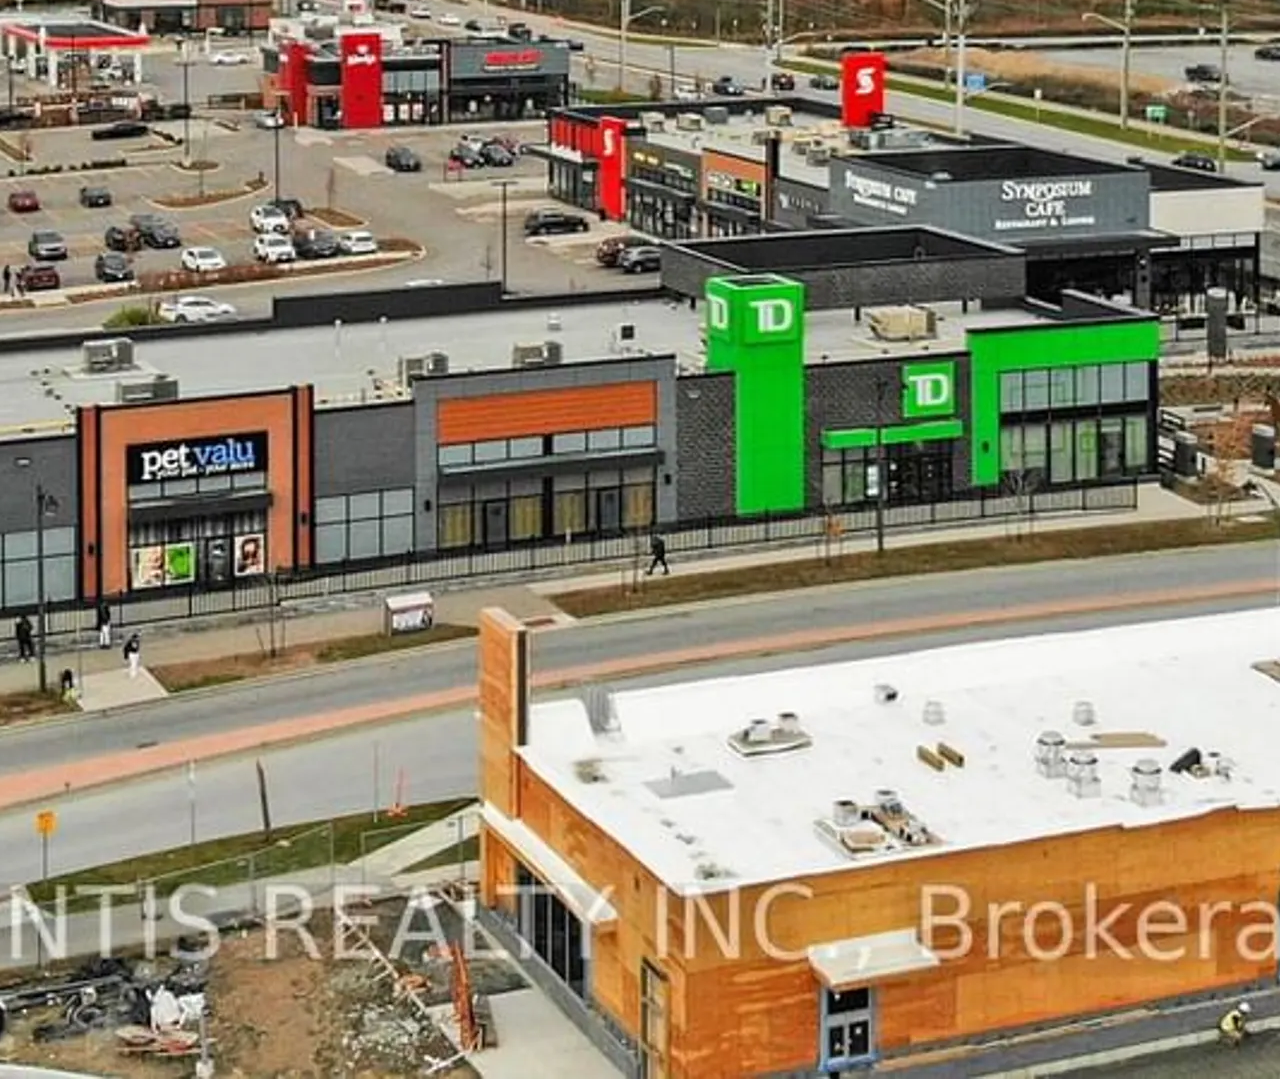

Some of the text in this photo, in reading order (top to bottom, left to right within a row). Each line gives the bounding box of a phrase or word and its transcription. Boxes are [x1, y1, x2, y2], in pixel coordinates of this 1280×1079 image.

[1001, 181, 1093, 201] SYMPOSIUM
[749, 298, 794, 333] TD
[907, 372, 949, 406] TD
[141, 438, 255, 480] pet valu
